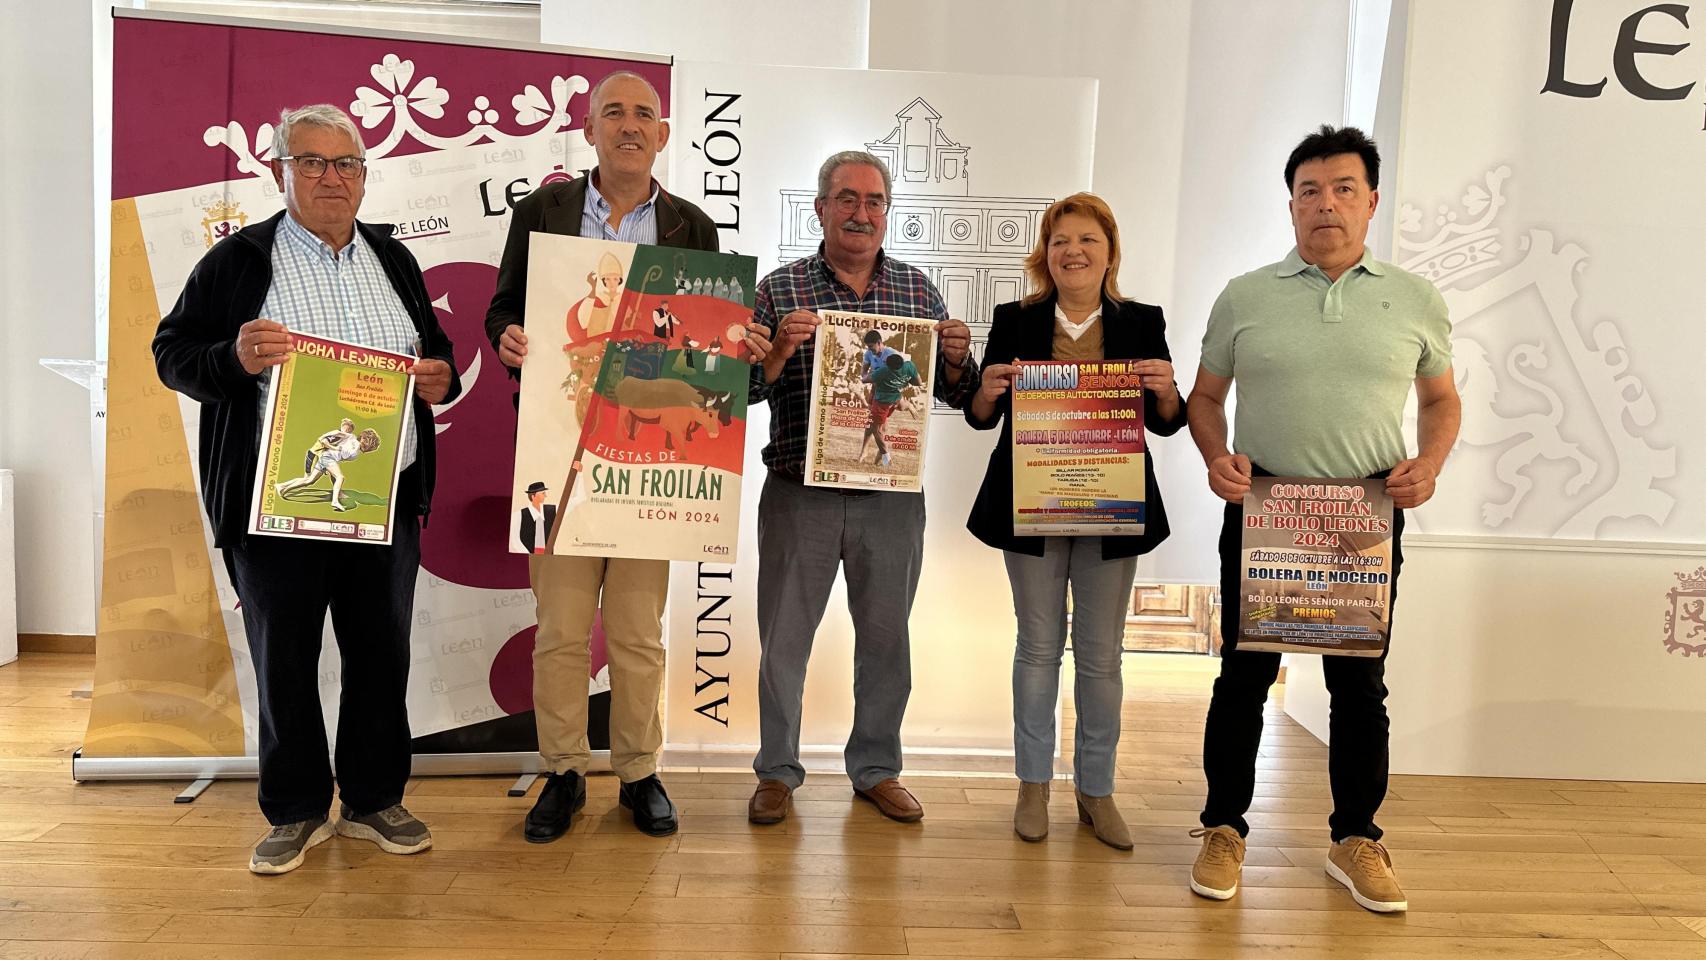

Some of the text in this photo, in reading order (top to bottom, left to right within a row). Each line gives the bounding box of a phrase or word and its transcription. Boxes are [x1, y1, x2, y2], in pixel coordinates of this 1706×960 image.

[692, 87, 742, 234] LEÓN
[412, 215, 449, 233] LEÓN
[828, 314, 930, 334] Lucha Leonesa
[294, 339, 407, 373] UCHA LEONESA
[358, 372, 384, 384] León
[1015, 360, 1136, 390] CONCURSO SAN FROILÁ
[1080, 375, 1140, 388] SENIOR
[280, 394, 288, 410] 2024
[1027, 391, 1066, 400] DEPORTES
[1067, 389, 1119, 399] AUTÓCTONOS
[1120, 390, 1141, 398] 2024
[835, 398, 862, 408] León
[276, 410, 286, 432] Base
[1017, 411, 1045, 420] Sábado
[1046, 412, 1051, 420] 5
[1052, 411, 1061, 420] de
[1062, 410, 1091, 420] octubre
[1098, 410, 1109, 419] las
[1110, 408, 1136, 419] 11:00h
[275, 433, 282, 445] de
[818, 437, 824, 447] de
[1016, 430, 1049, 445] BOLERA
[1050, 430, 1057, 444] 5
[1059, 430, 1071, 444] DE
[1072, 429, 1112, 444] OCTUBRE
[595, 442, 677, 464] FIESTAS DE
[270, 448, 280, 476] Verano
[1027, 458, 1077, 467] MODALIDADES
[1084, 456, 1130, 466] DISTANCIAS:
[269, 479, 276, 490] de
[592, 463, 723, 501] SAN FROILÁN
[1271, 484, 1365, 500] CONCURSO
[265, 492, 274, 510] Liga
[1263, 500, 1372, 516] SAN FROILÁN
[638, 508, 720, 524] LEÓN 2024
[1246, 515, 1389, 533] DE BOLO LEONÉS
[1293, 532, 1340, 548] 2024
[1250, 550, 1383, 566] SÁBADO 5 DE OCTUBRE A LAS 16:30H
[1248, 567, 1388, 585] BOLERA DE NOCEDO
[1306, 582, 1328, 591] LEÓN
[1248, 594, 1385, 608] BOLO LEONÉS SENIOR PAREJAS
[1292, 607, 1337, 619] PREMIOS
